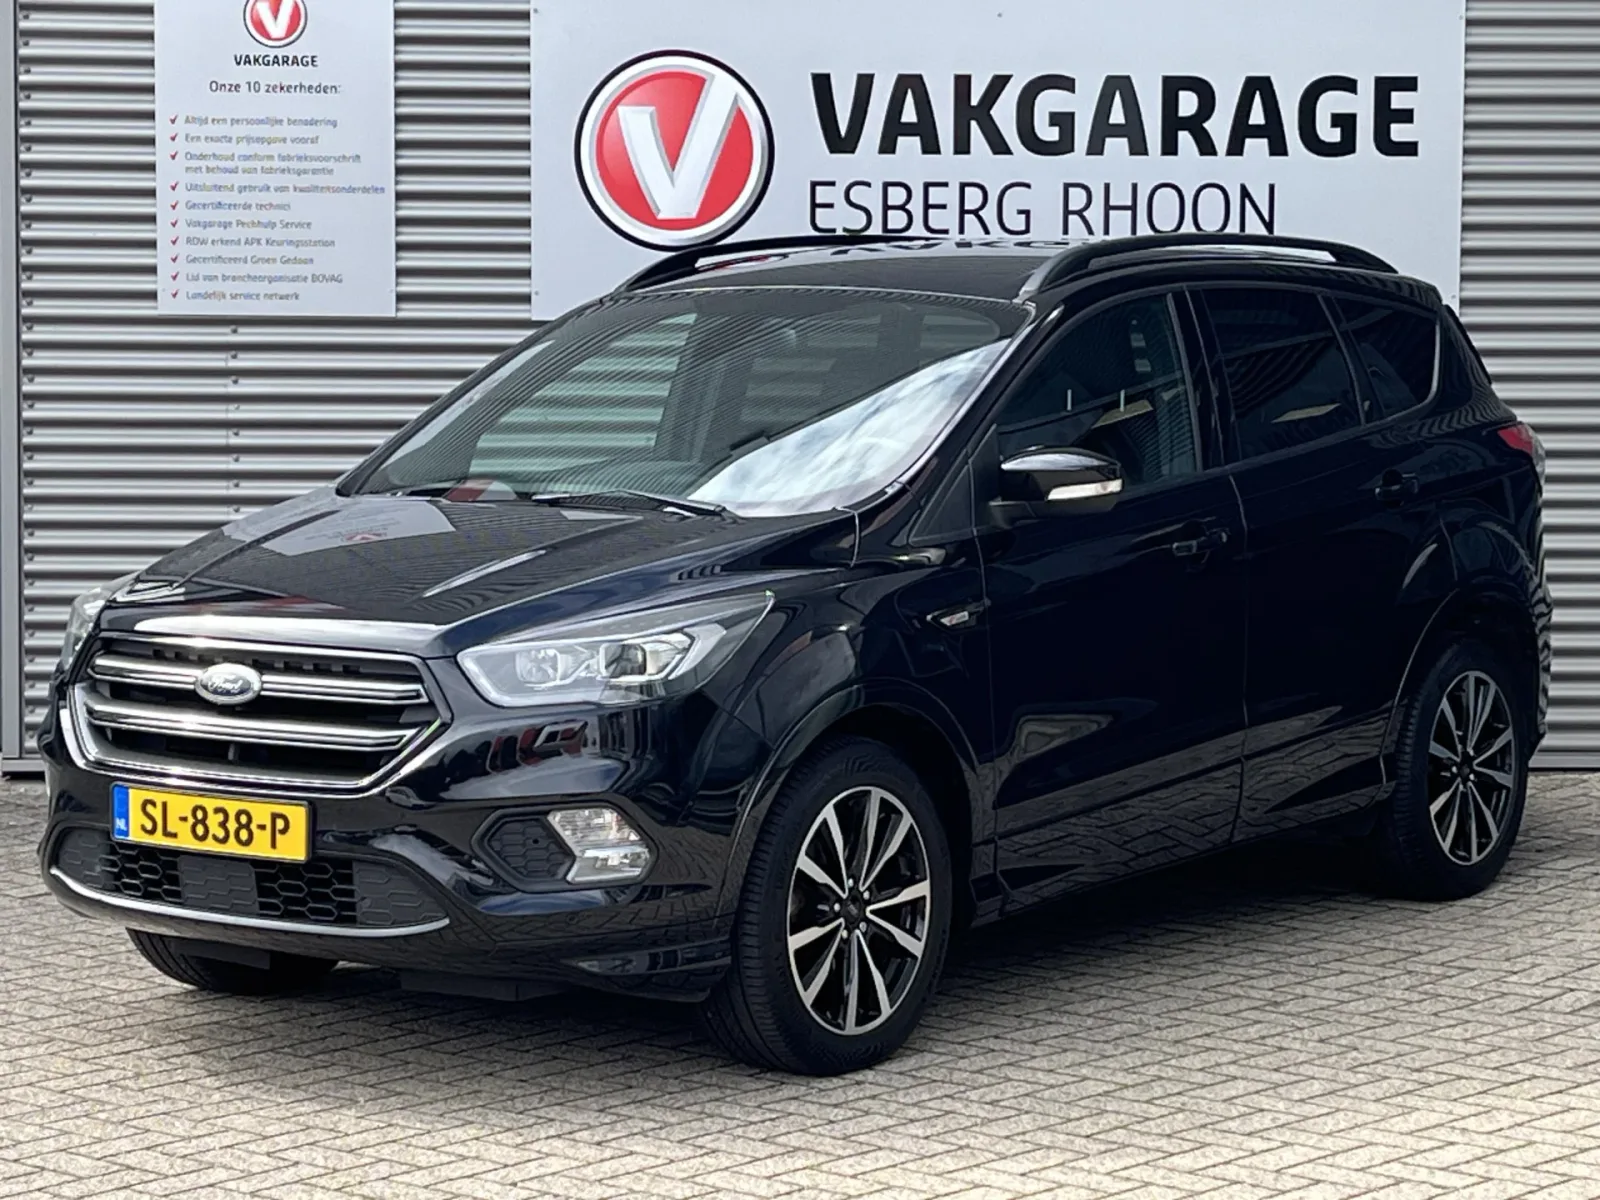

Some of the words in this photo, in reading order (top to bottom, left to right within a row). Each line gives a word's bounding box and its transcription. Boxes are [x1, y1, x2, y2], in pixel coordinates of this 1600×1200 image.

[233, 53, 319, 68] VAKGARAGE
[209, 80, 242, 94] Onze
[245, 80, 261, 94] 10
[264, 81, 341, 95] zekerheden:
[810, 72, 1420, 158] VAKGARAGE
[211, 118, 227, 126] een
[230, 116, 284, 128] persoonlijke
[287, 117, 338, 129] benadering
[184, 133, 202, 143] Een
[204, 136, 233, 144] exacte
[290, 135, 319, 145] vooraf
[619, 64, 741, 221] V
[184, 152, 235, 161] Onderhoud
[237, 153, 276, 162] conform
[184, 166, 203, 174] met
[205, 165, 240, 174] behoud
[260, 166, 335, 177] fabrieksgarantie
[237, 184, 271, 195] gebruik
[273, 186, 291, 194] van
[185, 200, 253, 211] Gecertificeerde
[810, 180, 1032, 236] ESBERG
[1061, 182, 1277, 237] RHOON
[185, 219, 233, 230] Vakgarage
[236, 219, 277, 230] Pechhulp
[279, 220, 313, 230] Service
[185, 236, 209, 246] RDW
[211, 238, 242, 246] erkend
[243, 237, 263, 246] APK
[185, 254, 248, 265] Gecertificeerd
[250, 255, 277, 265] Groen
[186, 272, 200, 282] Lid
[202, 274, 219, 282] van
[221, 272, 309, 285] brancheorganisatie
[311, 273, 344, 284] BOVAG
[228, 292, 261, 301] service
[263, 292, 300, 301] netwerk
[114, 817, 128, 831] NL
[139, 798, 291, 850] SL-838-P
